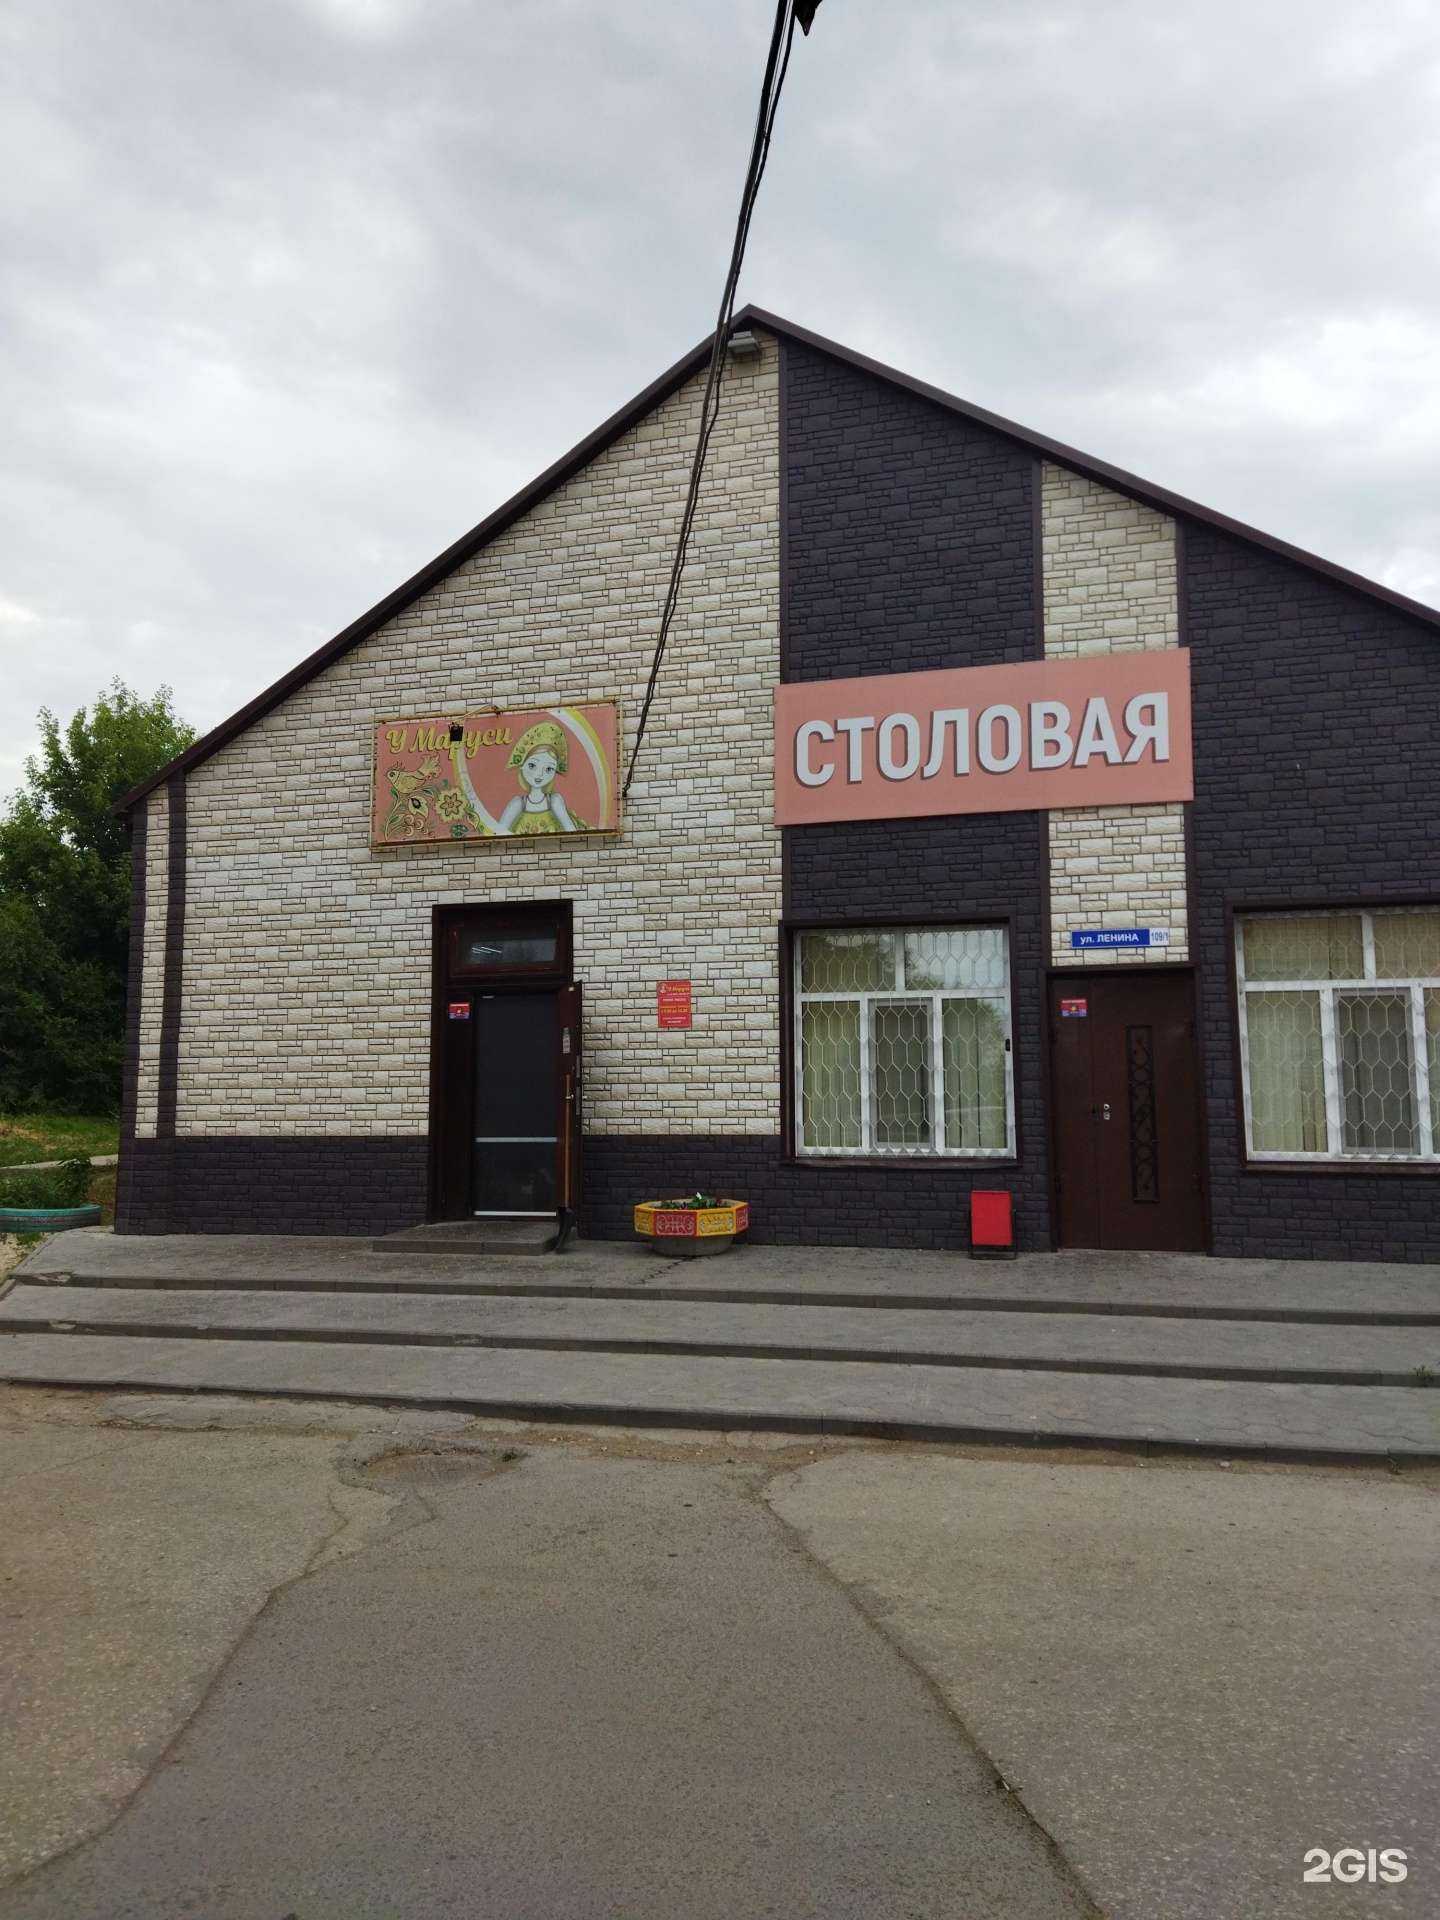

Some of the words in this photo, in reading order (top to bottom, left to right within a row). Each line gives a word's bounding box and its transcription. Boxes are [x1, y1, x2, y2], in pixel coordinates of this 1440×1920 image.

[385, 728, 408, 754] У
[794, 691, 1170, 787] СТОЛОВАЯ
[1080, 935, 1095, 945] ул.
[1097, 933, 1140, 943] ЛЕНИНА
